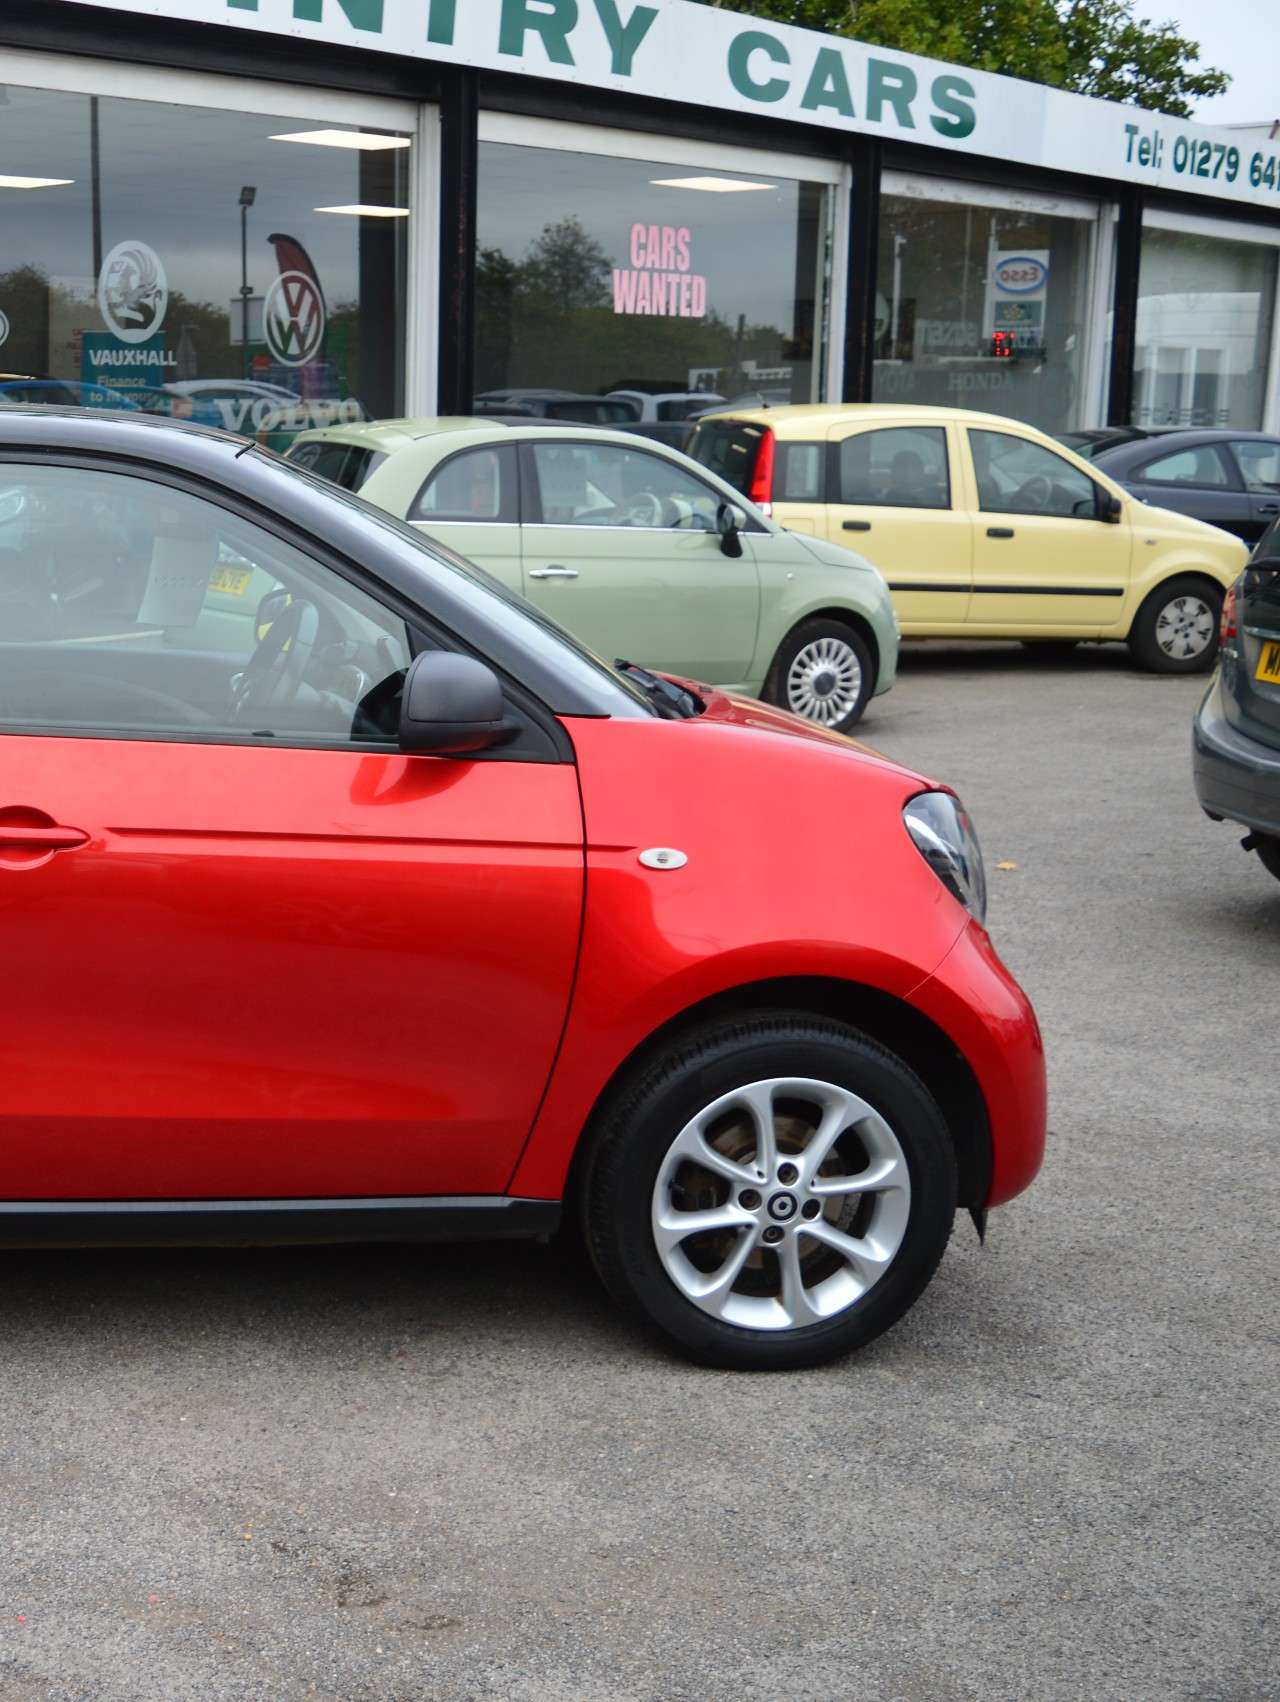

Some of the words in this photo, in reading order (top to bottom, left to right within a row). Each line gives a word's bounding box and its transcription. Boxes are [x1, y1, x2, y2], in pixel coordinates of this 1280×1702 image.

[728, 30, 976, 139] CARS
[1125, 124, 1163, 168] Tel:
[1173, 135, 1240, 182] 01279
[1250, 152, 1280, 191] 64
[631, 223, 691, 272] CARS
[613, 268, 706, 317] WANTED
[89, 350, 177, 366] VAUXHALL
[213, 398, 364, 431] VOLVO
